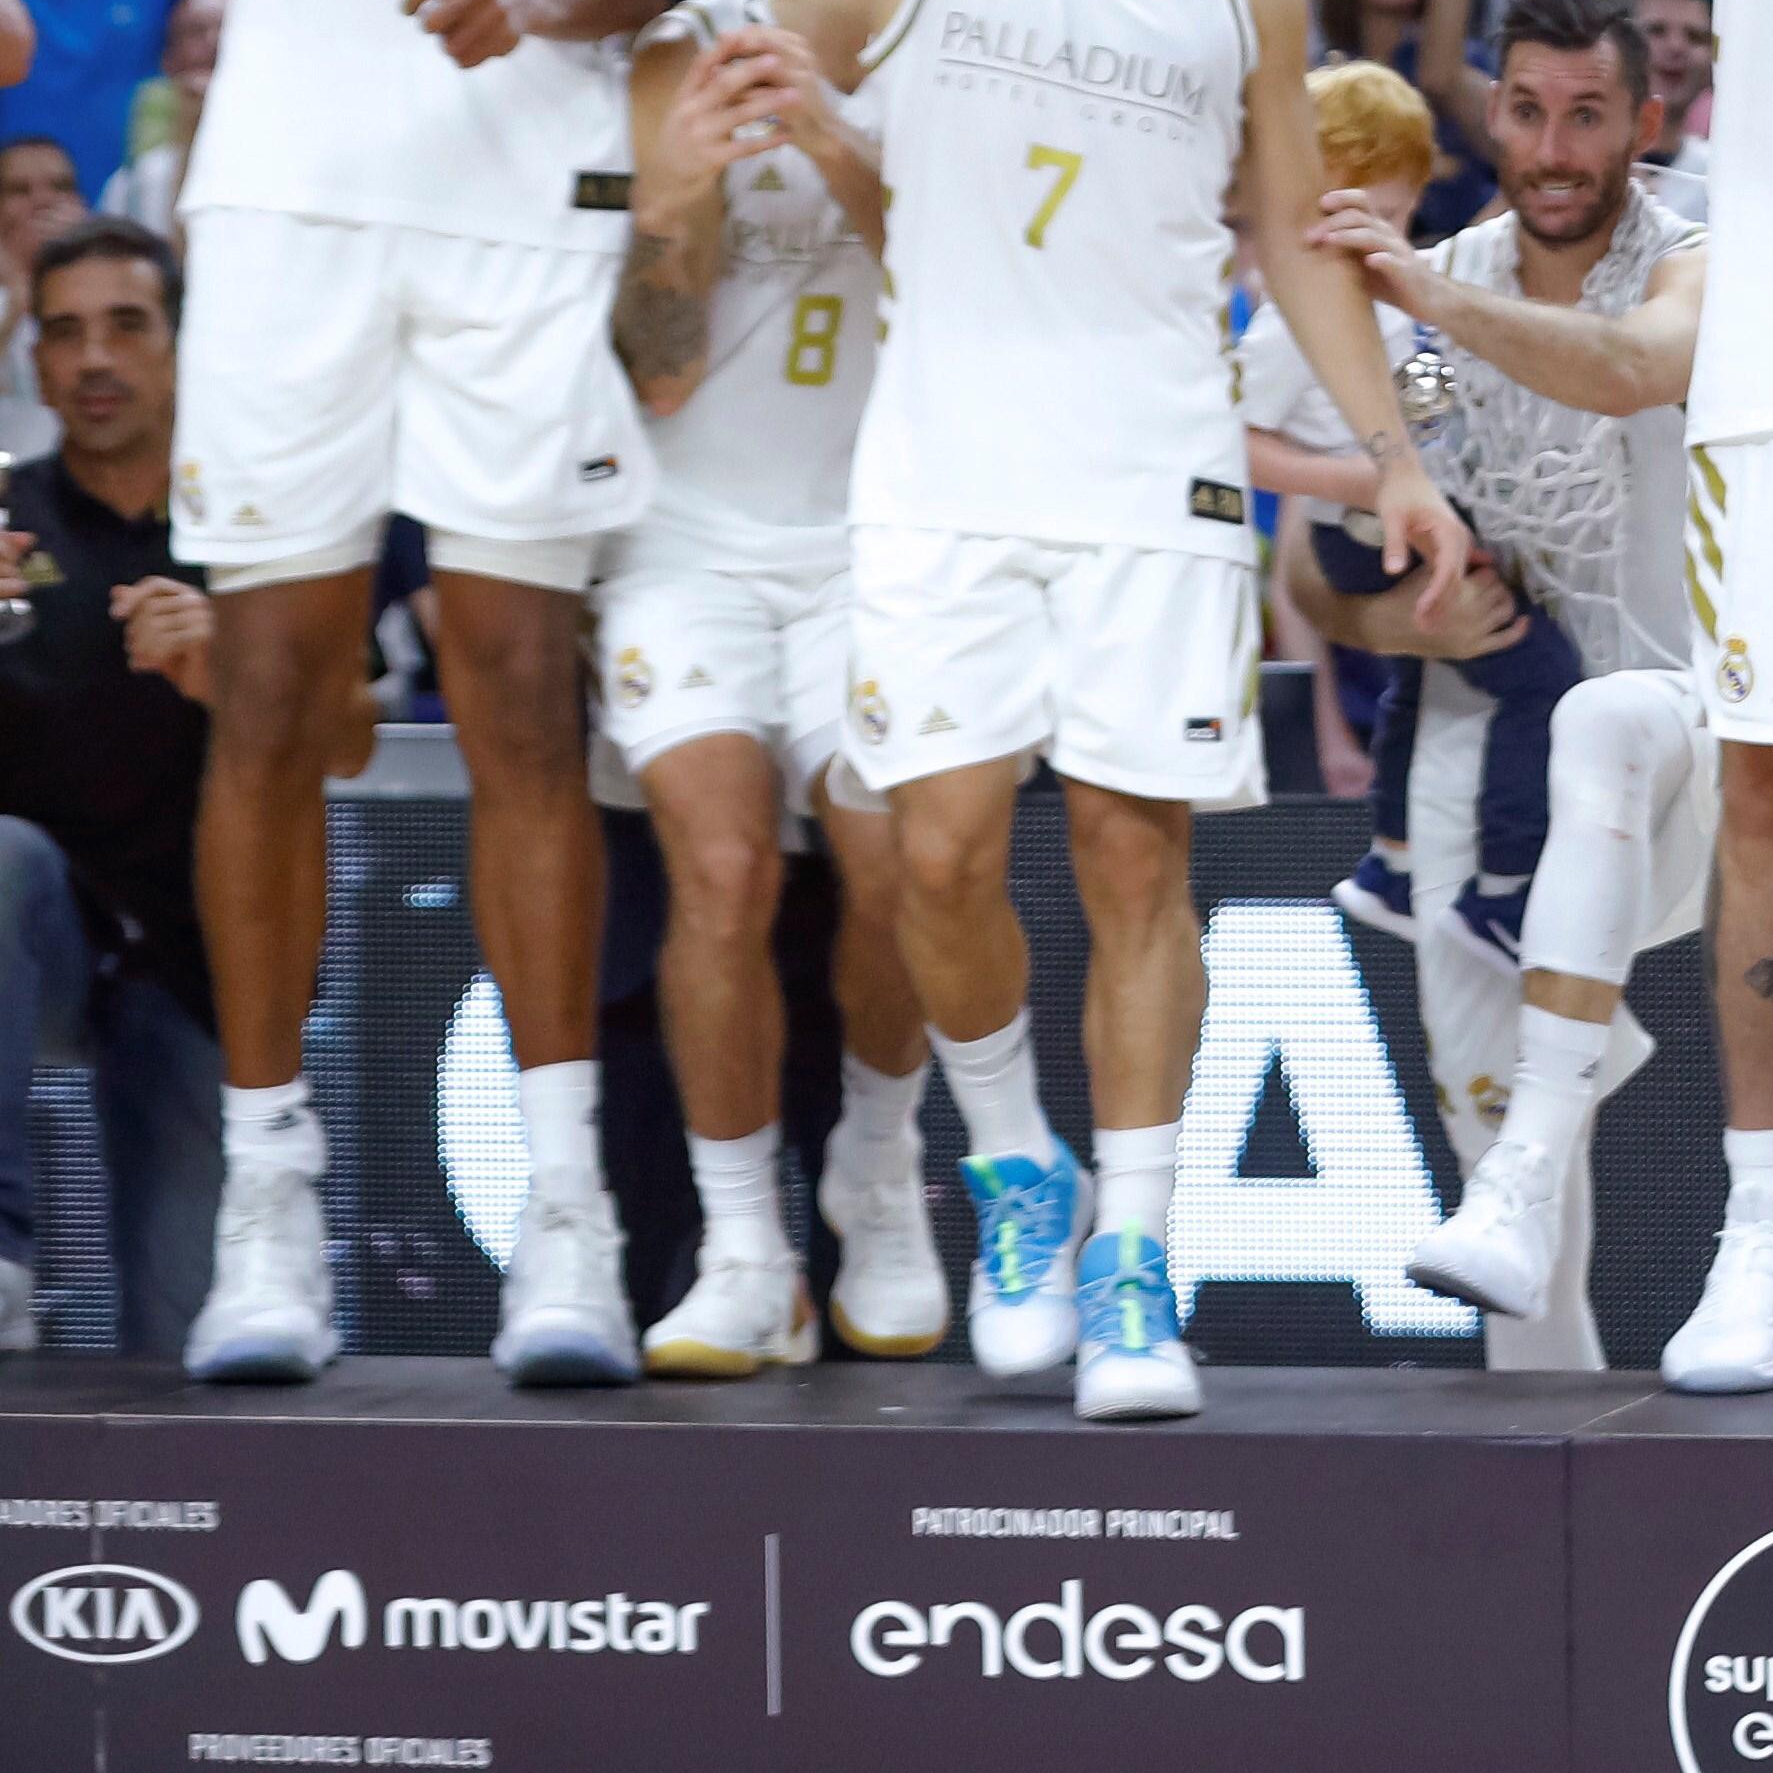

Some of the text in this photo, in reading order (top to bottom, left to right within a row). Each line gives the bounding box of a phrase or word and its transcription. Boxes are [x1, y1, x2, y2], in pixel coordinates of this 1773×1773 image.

[939, 10, 1208, 117] PALLADIUM
[1025, 141, 1084, 251] 7
[784, 293, 844, 387] 8
[911, 1507, 1240, 1539] PATROCINADOR PRINCIPAL
[43, 1587, 168, 1639] KIA
[383, 1591, 709, 1653] movistar
[849, 1578, 1305, 1682] endesa
[187, 1732, 361, 1764] PROVEEDORES
